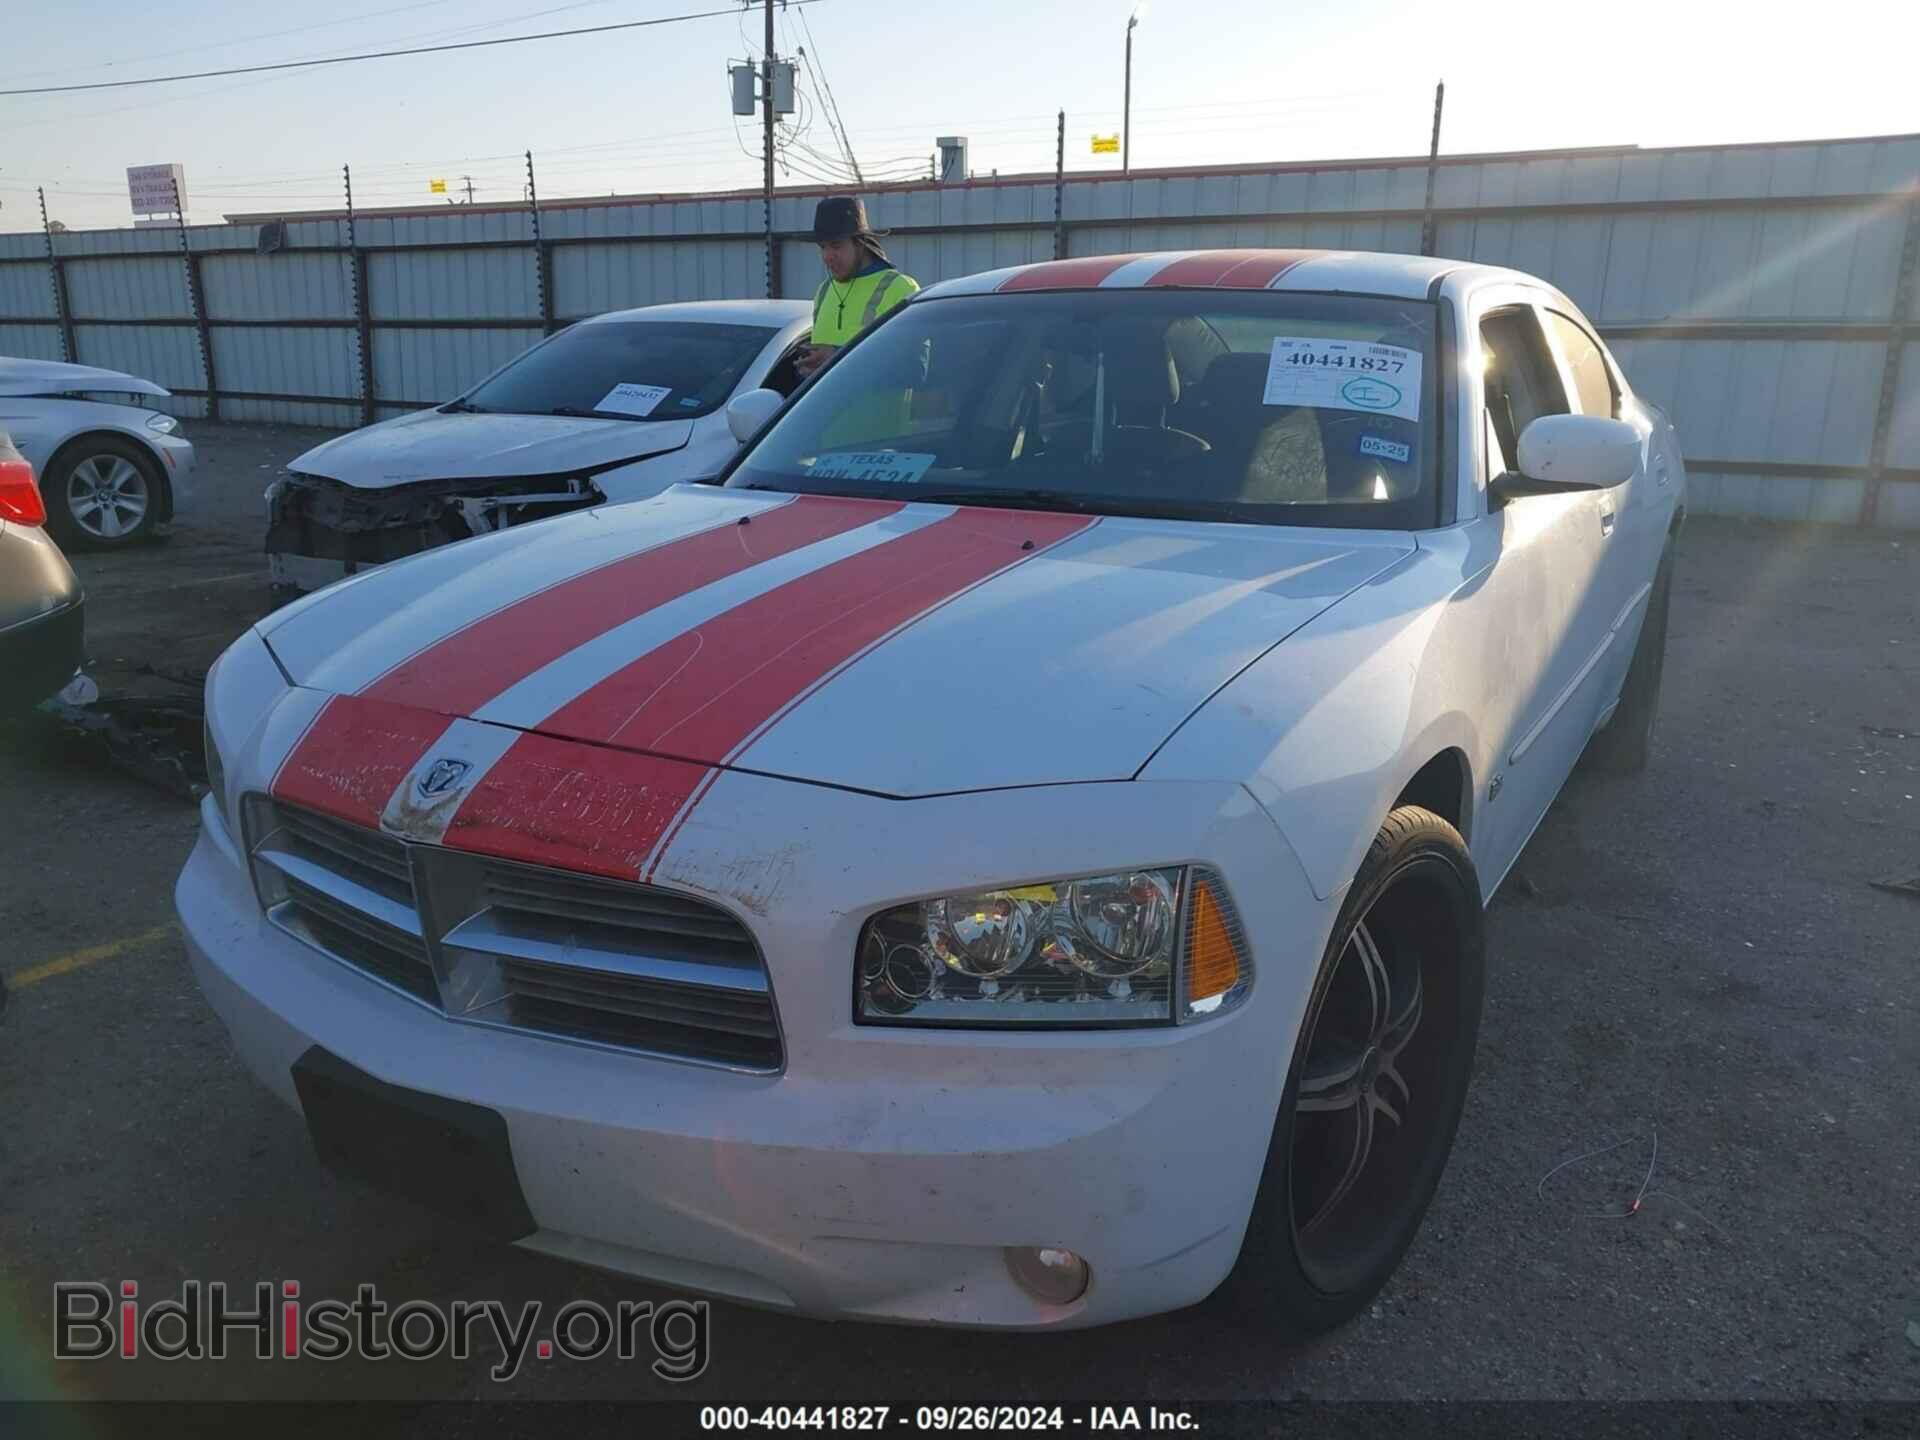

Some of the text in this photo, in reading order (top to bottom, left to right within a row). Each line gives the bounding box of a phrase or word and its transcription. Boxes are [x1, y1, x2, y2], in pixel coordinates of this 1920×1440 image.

[1286, 352, 1404, 374] 40441827
[1363, 439, 1406, 457] 05-25
[849, 454, 895, 465] TEXAS
